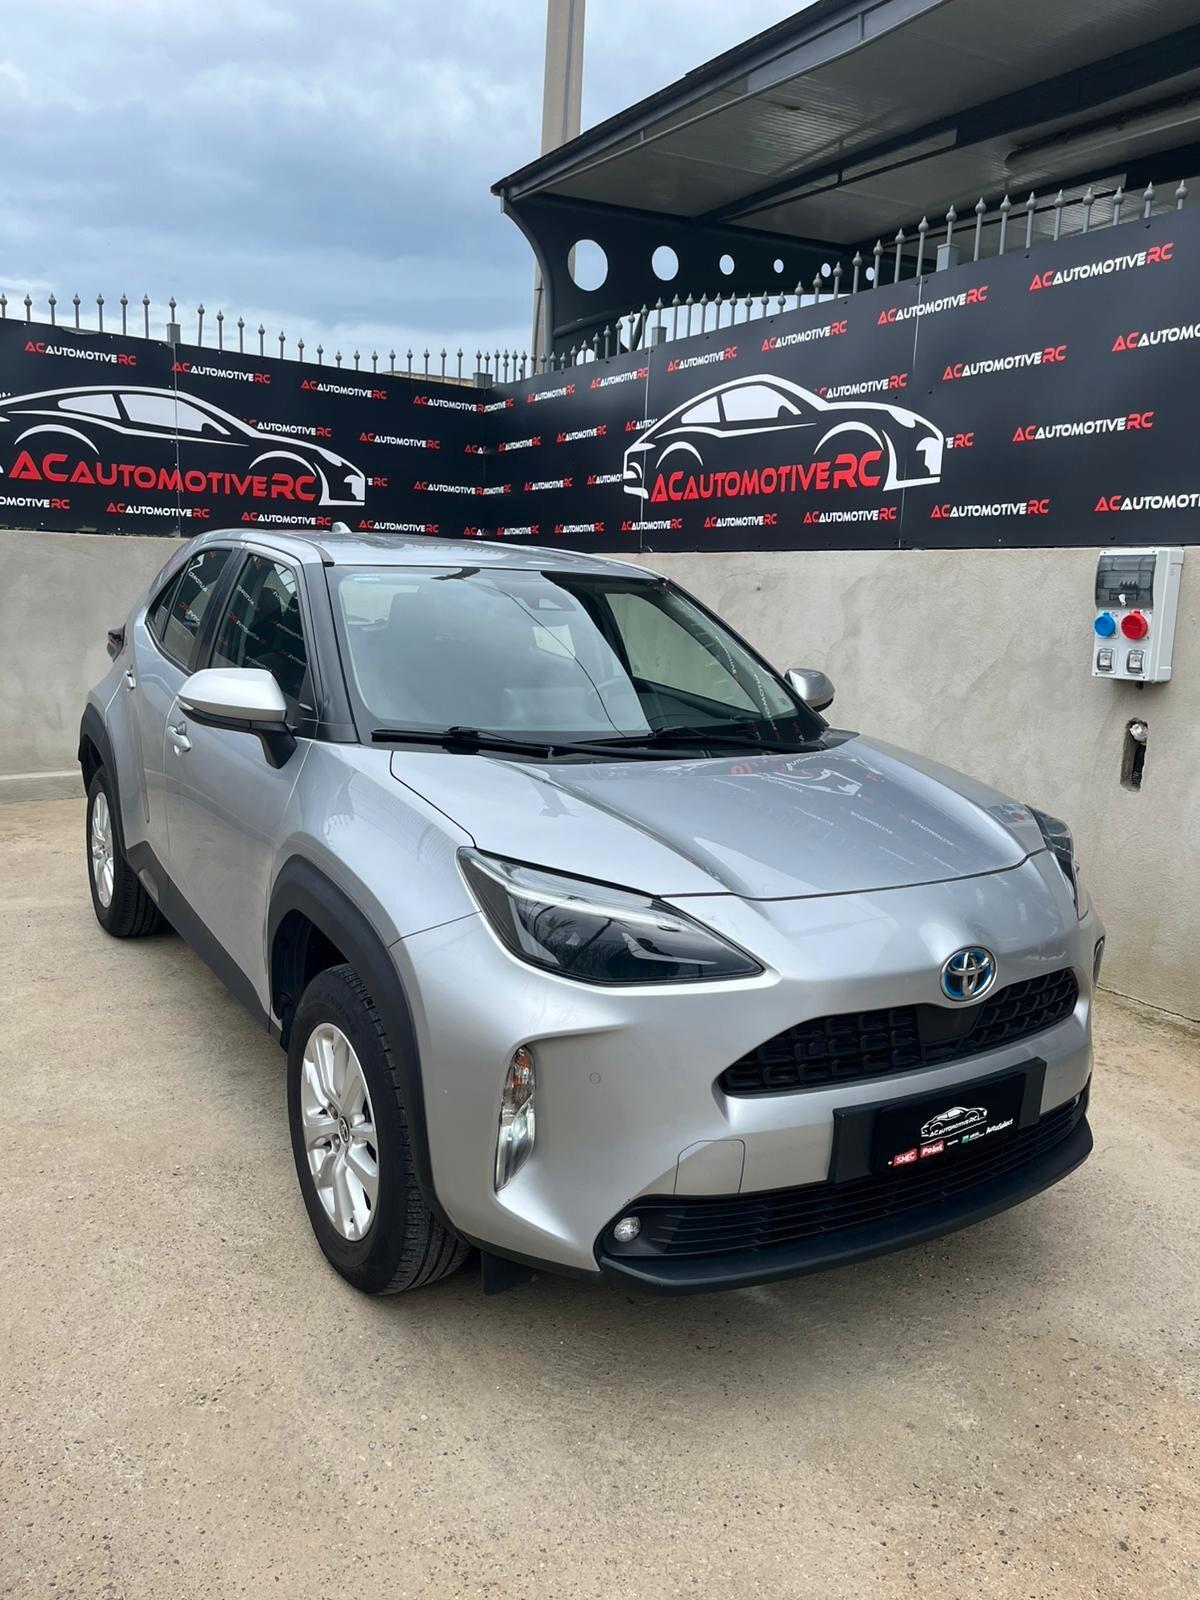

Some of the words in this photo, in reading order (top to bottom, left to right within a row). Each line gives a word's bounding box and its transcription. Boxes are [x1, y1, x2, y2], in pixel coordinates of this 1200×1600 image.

[1029, 242, 1174, 291] ACAUTOMOTIVERC
[877, 286, 989, 325] ACAUTOMOTIVERC
[761, 320, 848, 352] ACAUTOMOTIVERC
[24, 340, 136, 366] ACAUTOMOTIVERC
[667, 347, 737, 372] ACAUTOMOTIVERC
[943, 345, 1067, 381] ACAUTOMOTIVERC
[171, 361, 271, 384] ACAUTOMOTIVERC
[590, 367, 649, 390] ACAUTOMOTIVERC
[301, 379, 387, 400] ACAUTOMOTIVERC
[527, 384, 575, 403] ACAUTOMOTIVERC
[814, 373, 908, 399] AUTOMOTIVERC
[484, 397, 514, 413] TOMOTIVERC
[243, 418, 332, 437] AUTOMOTIVERC
[625, 418, 658, 432] ACAUTO
[1012, 411, 1155, 443] ACAUTOMOTIVERC
[360, 432, 440, 449] ACAUTOMOTIVERC
[8, 450, 318, 502] ACAUTOMOTIVERC
[651, 450, 884, 503] ACAUTOMOTIVERC
[106, 502, 210, 518] ACAUTOMOTIVERC
[930, 498, 1050, 518] ACAUTOMOTIVERC
[1094, 494, 1200, 511] ACAUTOMOT
[241, 511, 332, 526] ACAUTOMOTIVERC
[621, 518, 683, 532] ACAUTOMOTIVERC
[704, 513, 778, 528] ACAUTOMOTIVERC
[803, 507, 897, 524] ACAUTOMOTIVERC
[359, 519, 439, 533] ACAUTOMOTIVERC
